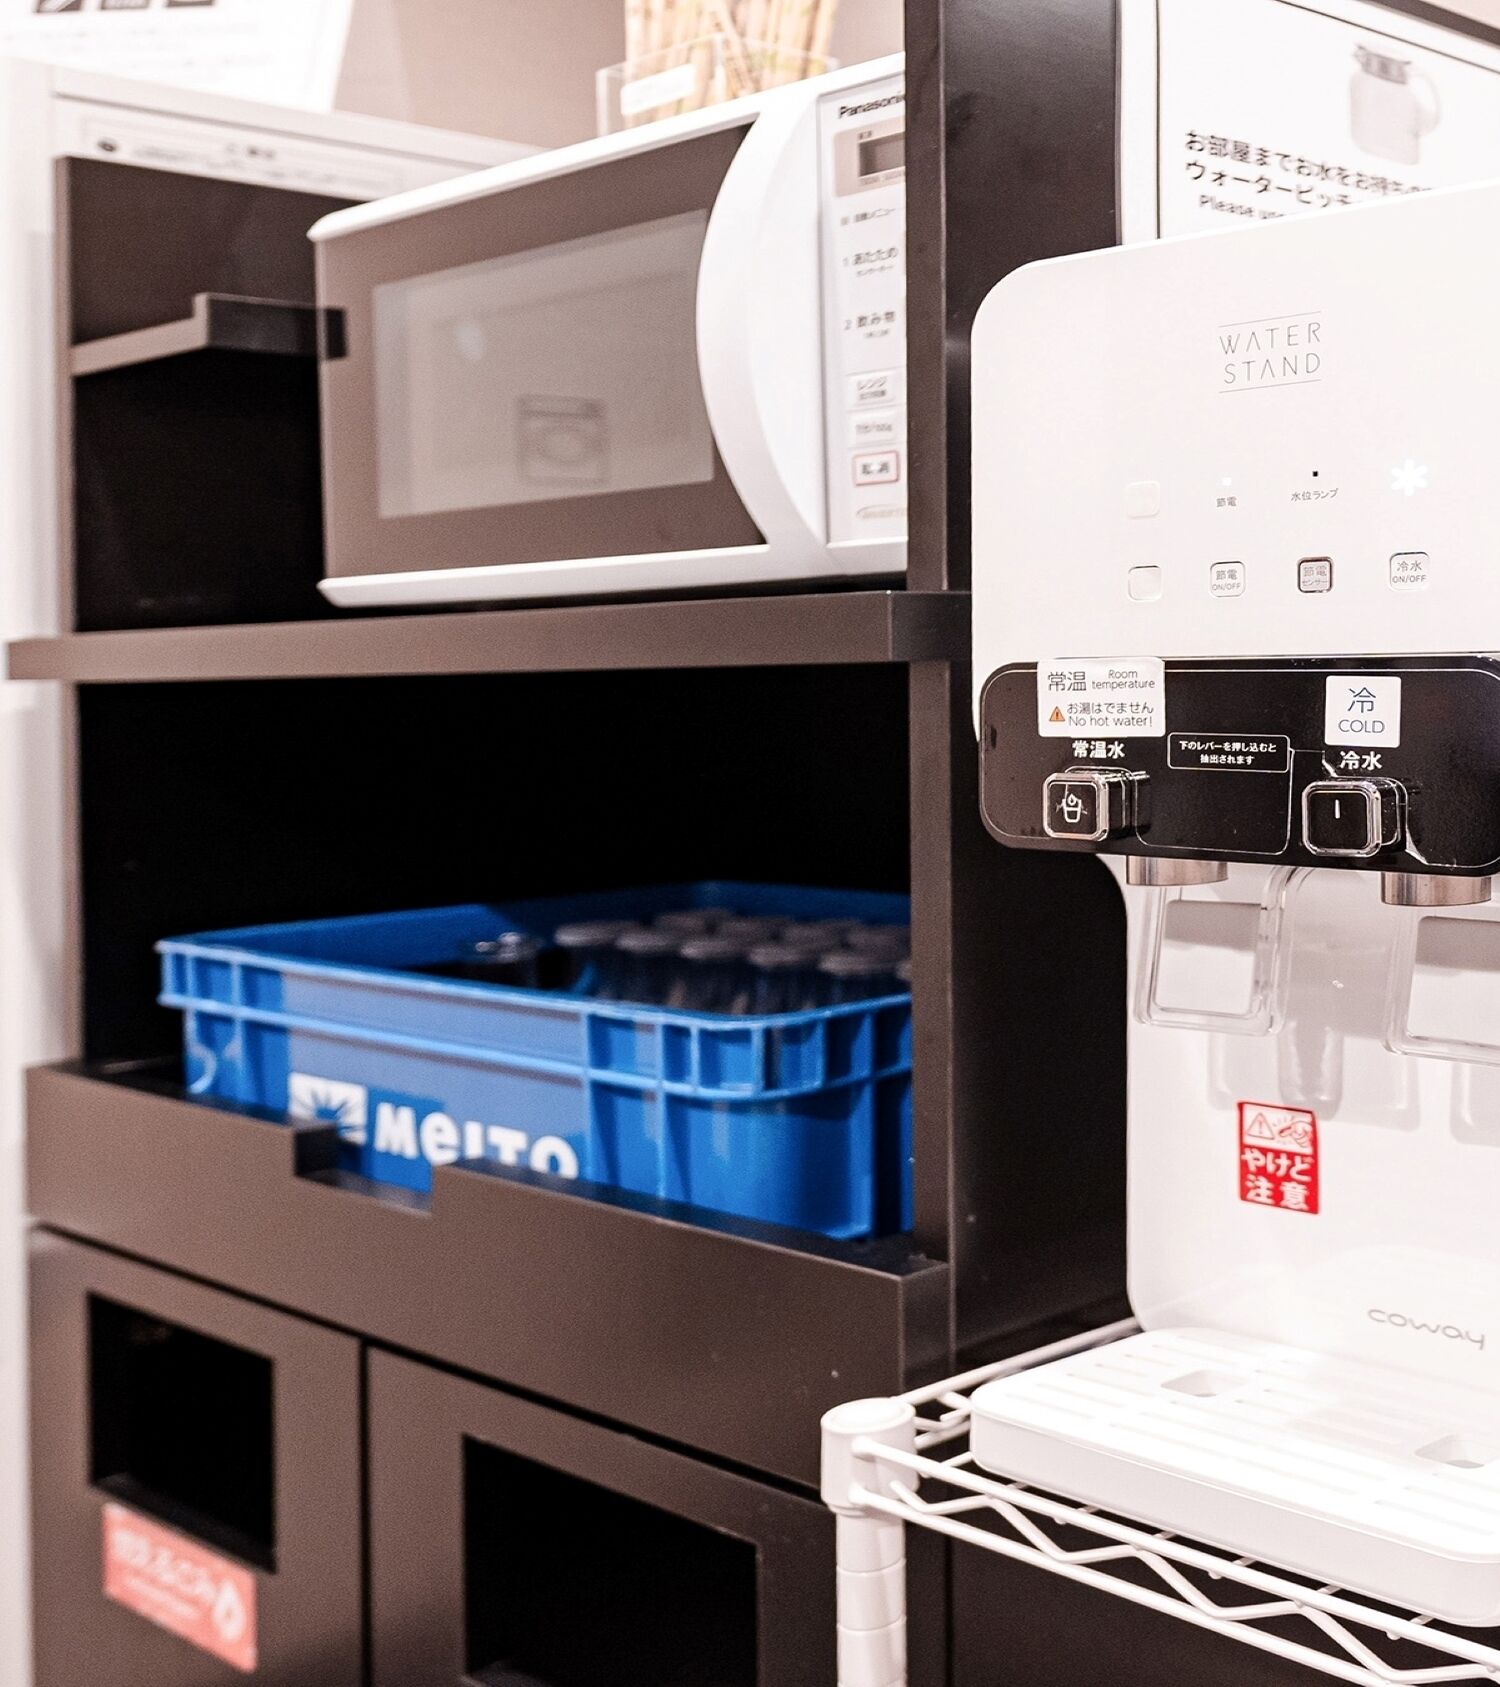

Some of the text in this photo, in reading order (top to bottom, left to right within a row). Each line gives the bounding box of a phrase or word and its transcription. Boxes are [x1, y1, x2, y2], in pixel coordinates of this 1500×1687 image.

[839, 91, 905, 119] Panasoni
[1199, 194, 1254, 218] Please
[1219, 322, 1321, 355] WATER
[1223, 352, 1321, 384] STAND
[1216, 496, 1237, 508] 節電
[1291, 488, 1339, 502] 水位ランプ
[1302, 565, 1328, 577] 節電
[1396, 560, 1422, 572] 冷水
[1216, 569, 1238, 581] 節電
[1392, 574, 1427, 584] ON/OFF
[1211, 582, 1241, 592] ON/OFF
[1108, 669, 1138, 679] Room
[1048, 671, 1087, 692] 常温
[1092, 680, 1156, 691] temperature
[1347, 686, 1376, 714] 冷
[1067, 702, 1154, 715] お湯はでません
[1068, 716, 1086, 727] No
[1090, 716, 1109, 727] hot
[1338, 719, 1385, 734] COLD
[1072, 740, 1125, 759] 常温水
[1179, 740, 1277, 753] 下のレバーを押し込むと
[1200, 754, 1255, 765] 抽出されます
[1340, 750, 1382, 771] 冷水
[1242, 1147, 1316, 1182] やけど
[1245, 1173, 1310, 1210] 注意
[1367, 1309, 1486, 1350] coway
